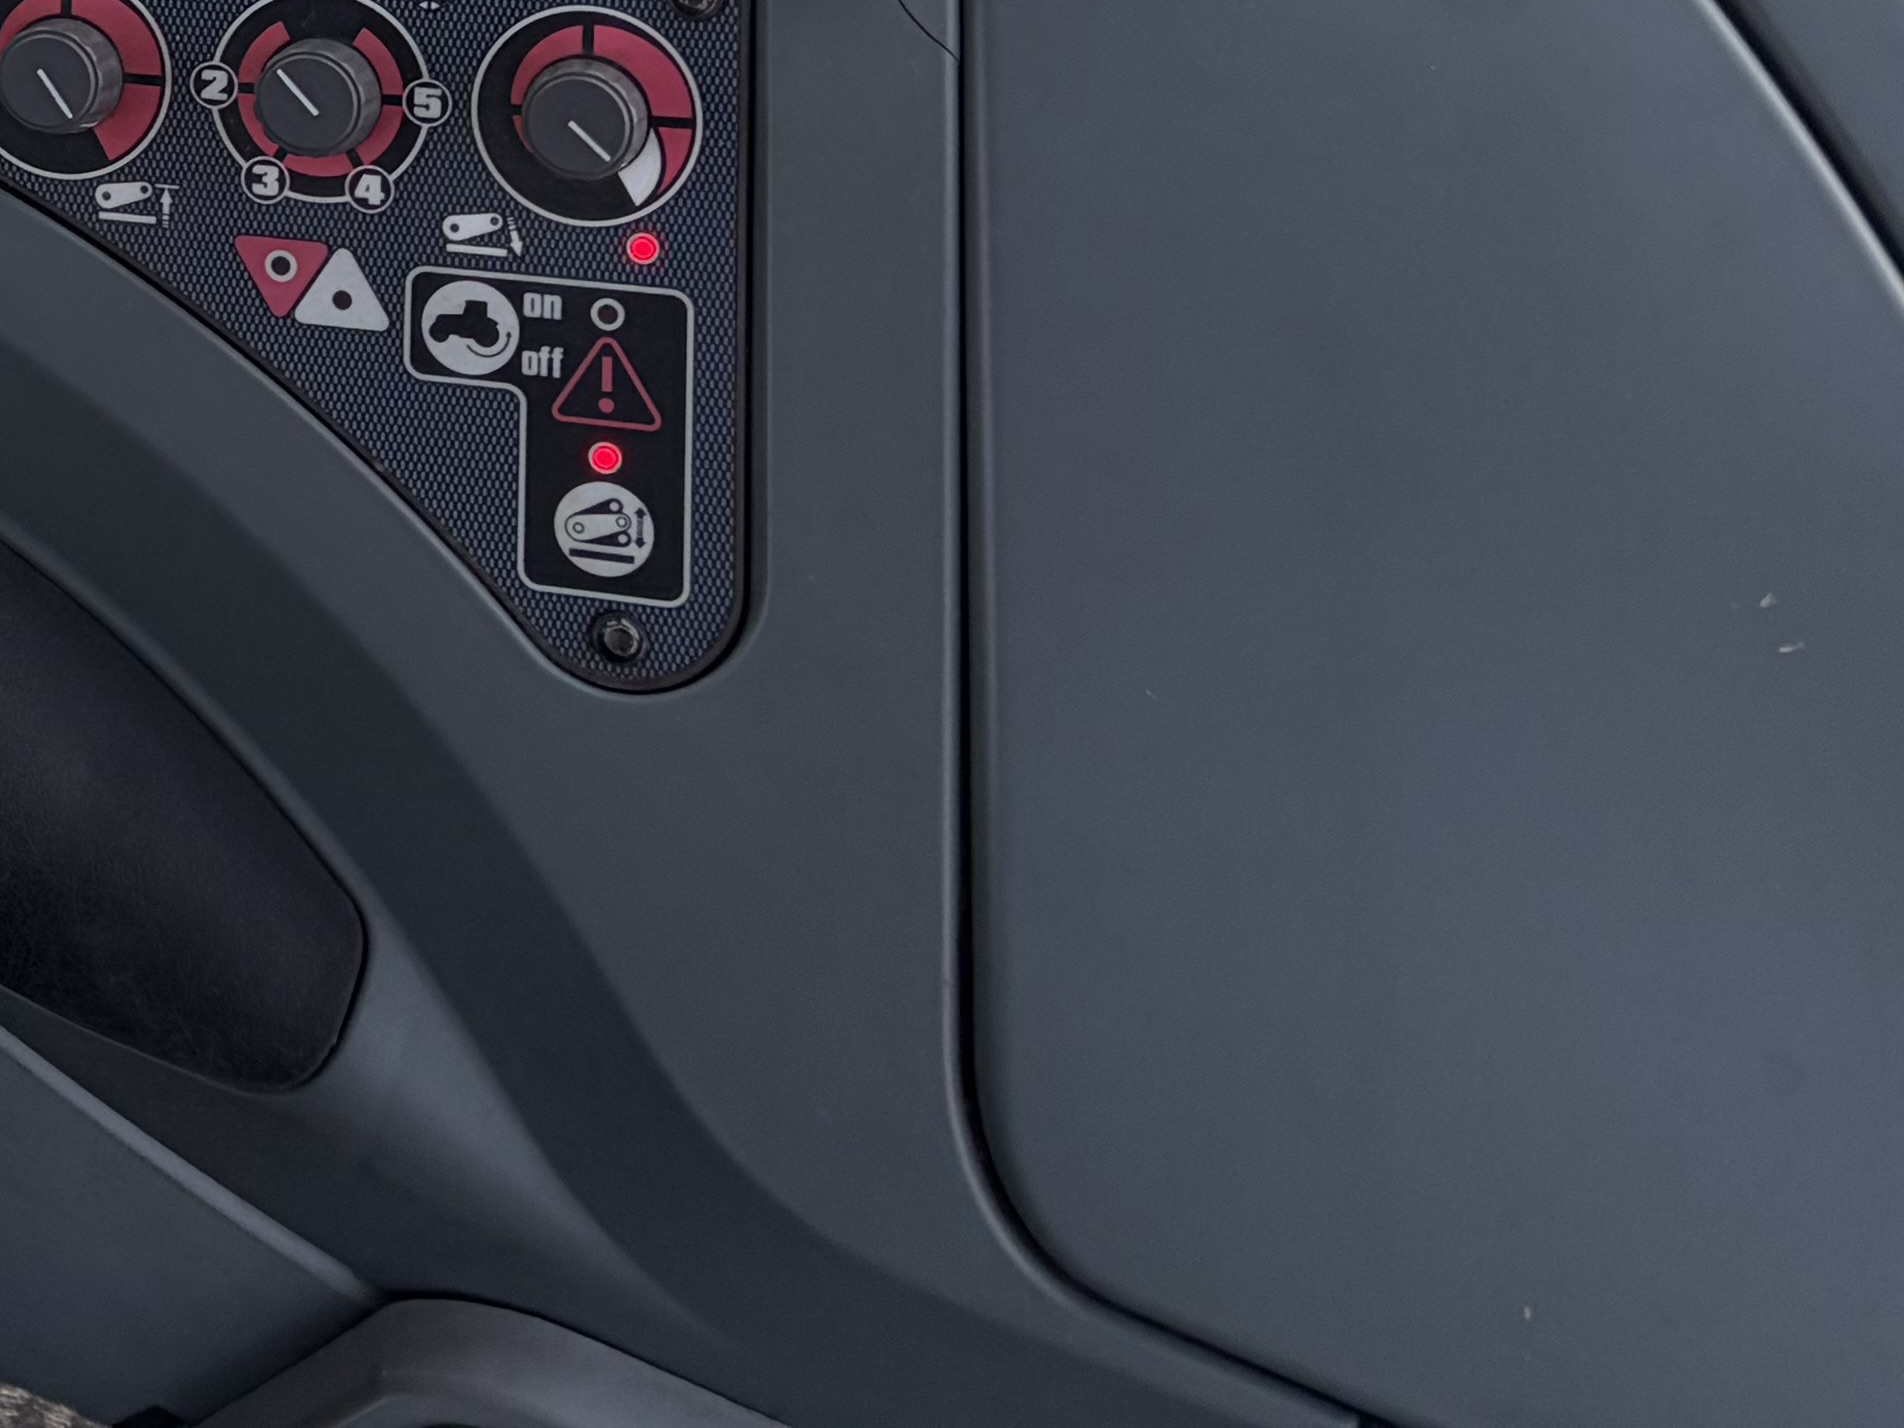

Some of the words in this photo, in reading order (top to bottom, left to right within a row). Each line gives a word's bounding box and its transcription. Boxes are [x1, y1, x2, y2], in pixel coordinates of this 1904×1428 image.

[201, 69, 230, 100] 2
[413, 87, 442, 120] 5
[251, 166, 280, 198] 3
[354, 173, 387, 206] 4
[523, 291, 562, 322] on
[521, 347, 564, 380] off
